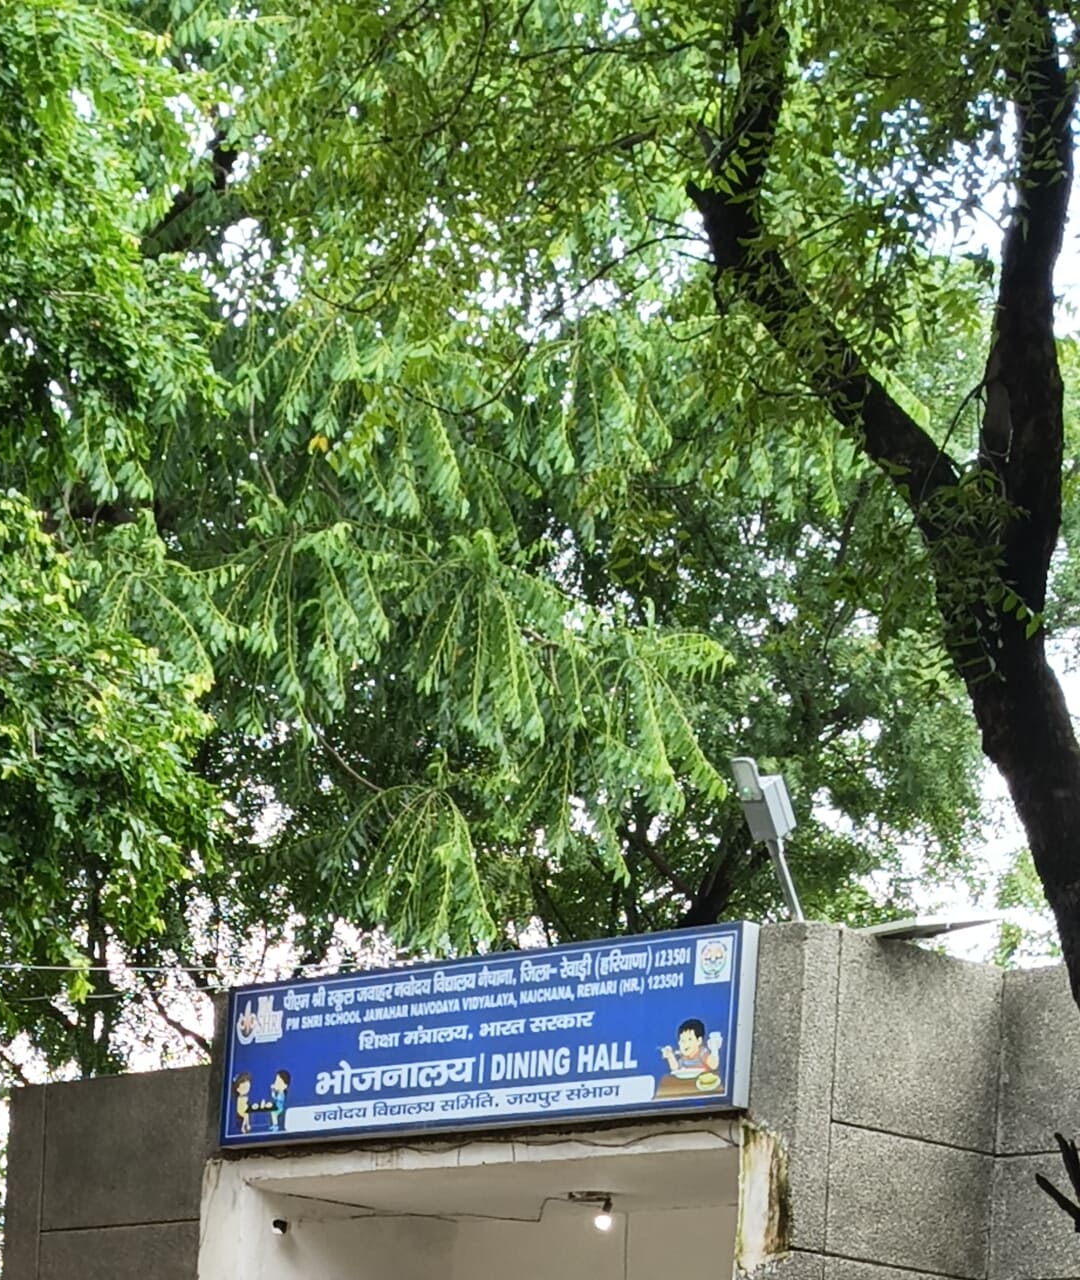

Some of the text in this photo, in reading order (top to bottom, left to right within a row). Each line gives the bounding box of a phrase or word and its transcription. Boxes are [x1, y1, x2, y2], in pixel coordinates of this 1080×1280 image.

[283, 990, 309, 1011] पीएम
[311, 985, 326, 1009] श्री
[327, 988, 355, 1012] स्कूल
[357, 983, 393, 1004] जवाहर
[394, 975, 431, 998] नवोदय
[433, 971, 476, 994] विद्यालय
[560, 952, 592, 982] रेवाड़ी
[595, 945, 652, 981] (हरियाणा)
[655, 947, 691, 968] 123501
[286, 973, 684, 1031] PM SHRI SCHOOL JAWAHAR NAVODAYA VIDYALAYA, NAICHANA, REWARI (HR.) 123501
[358, 1030, 400, 1051] शिक्षा
[479, 1019, 526, 1038] भारत
[530, 1011, 595, 1033] सरकार
[315, 1059, 476, 1095] भोजनालय
[490, 1047, 570, 1082] DINING
[577, 1041, 638, 1073] HALL
[314, 1106, 367, 1122] नवोदय
[373, 1101, 434, 1118] विद्यालय
[506, 1089, 561, 1109] जयपुर
[565, 1083, 620, 1101] संभाग
